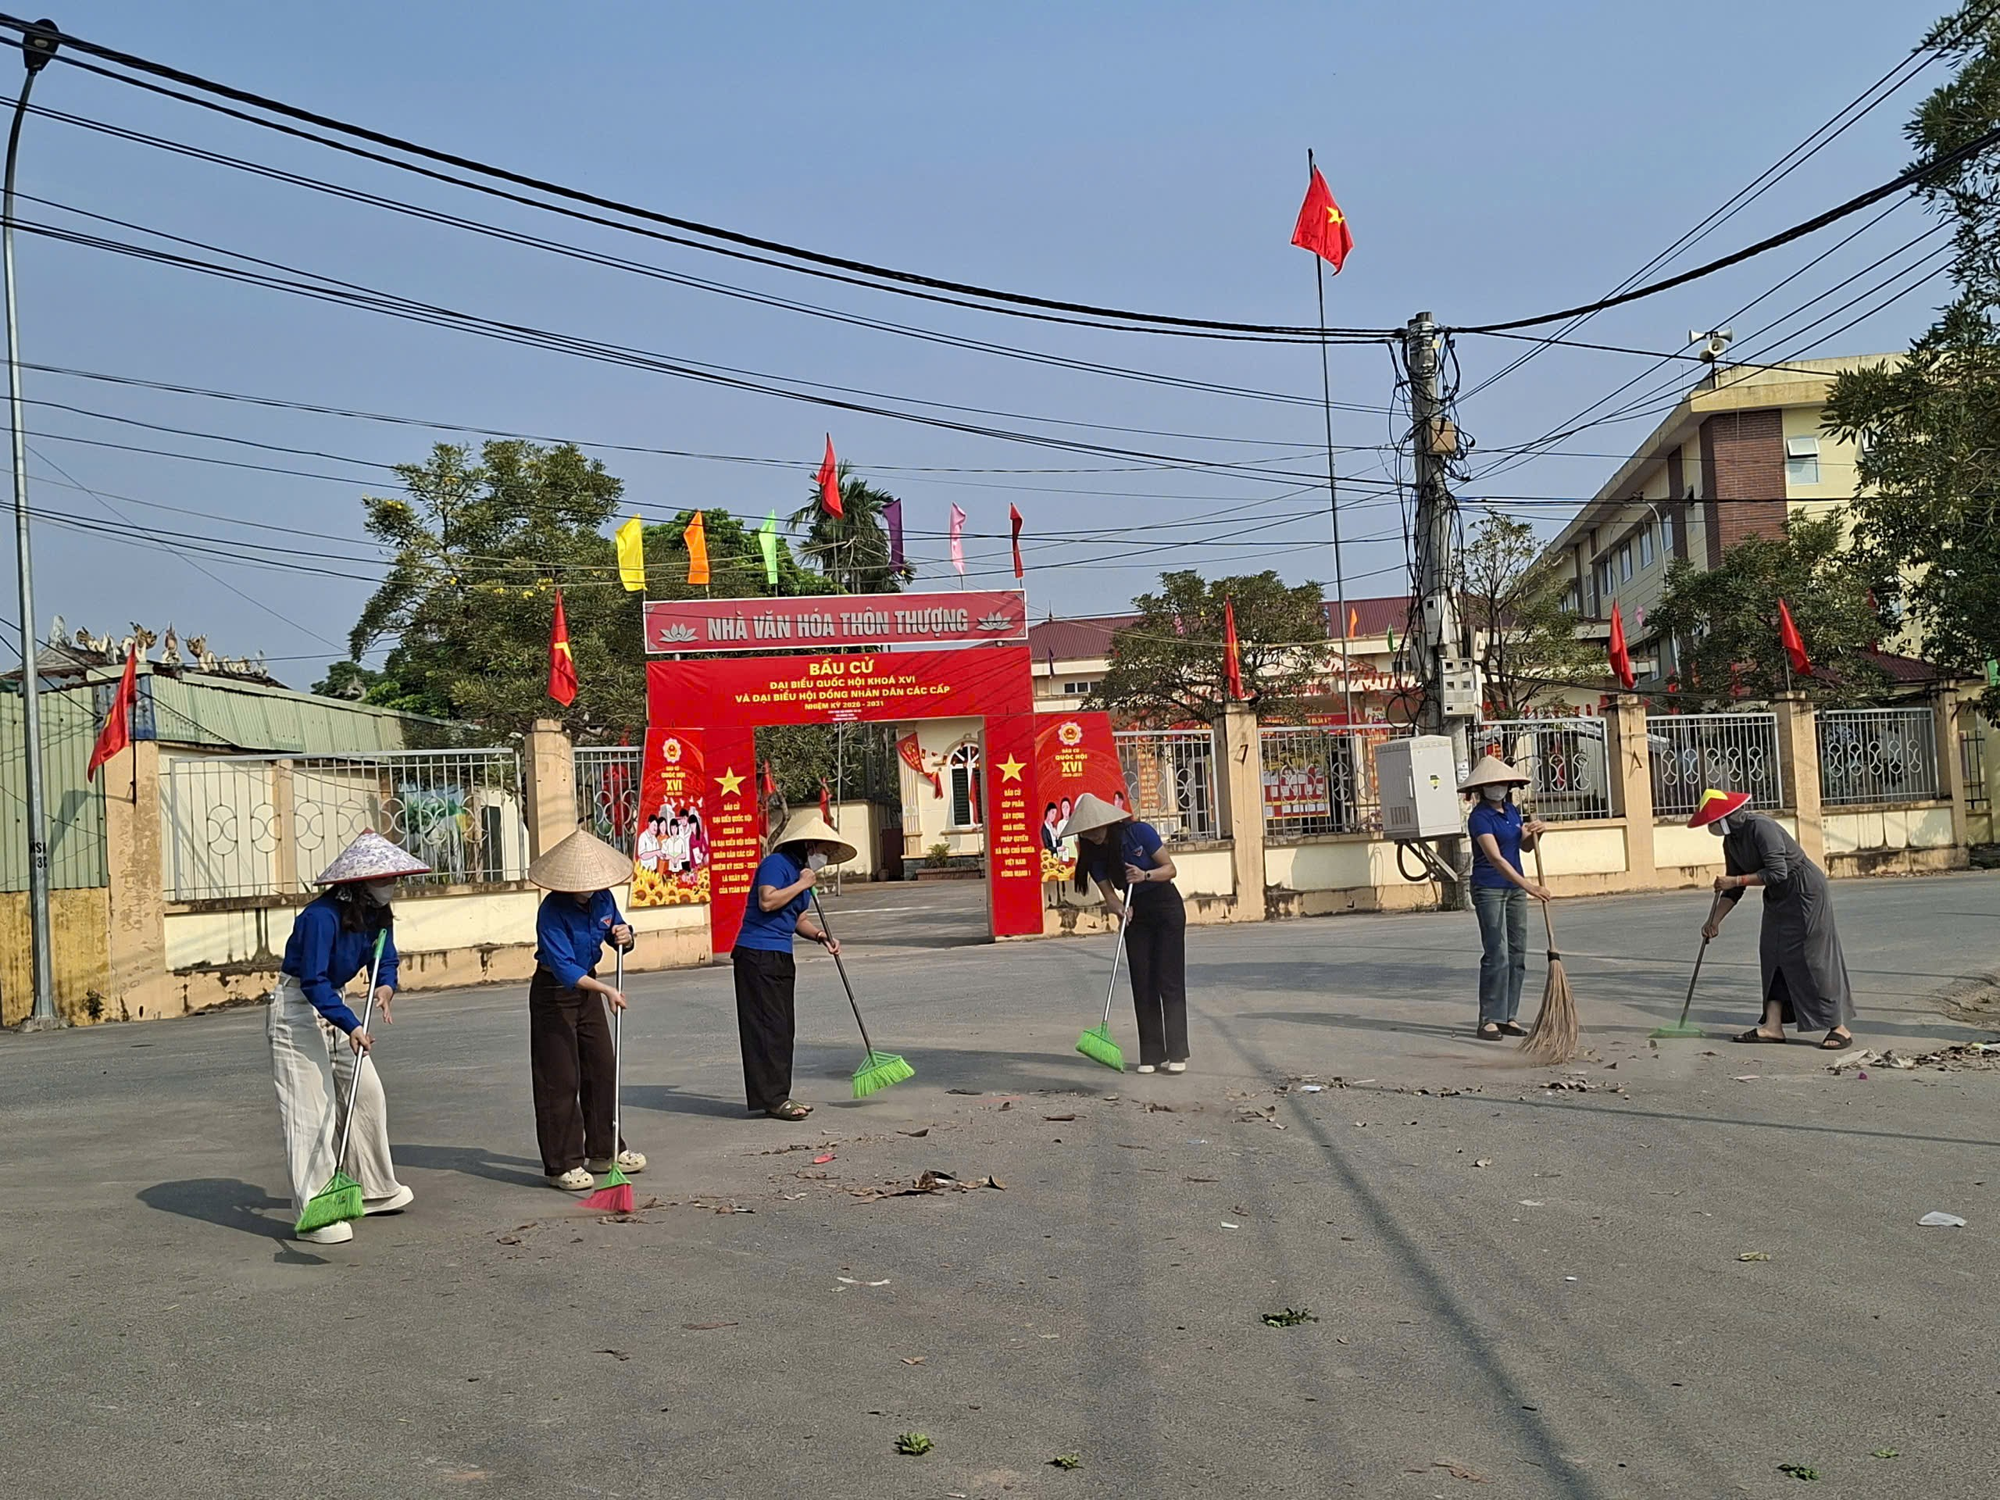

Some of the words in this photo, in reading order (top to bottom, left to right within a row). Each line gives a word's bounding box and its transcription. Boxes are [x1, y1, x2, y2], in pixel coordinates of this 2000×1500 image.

[707, 611, 748, 641] NHÀ
[753, 610, 791, 639] VĂN
[797, 608, 835, 638] HÓA
[839, 607, 889, 636] THÔN
[895, 607, 969, 638] THƯỢNG
[809, 658, 844, 676] BẦU
[849, 656, 875, 674] CỬ
[770, 681, 788, 690] ĐẠI
[791, 677, 814, 689] BIỂU
[816, 676, 845, 687] QUỐC
[847, 676, 865, 687] HỘI
[898, 675, 916, 684] XVI
[735, 692, 750, 703] VÀ
[752, 693, 771, 704] ĐẠI
[773, 690, 797, 701] BIỂU
[799, 690, 817, 701] HỘI
[850, 687, 880, 698] NHÂN
[882, 687, 905, 697] DÂN
[906, 685, 928, 695] CÁC
[929, 683, 950, 694] CẤP
[1061, 761, 1083, 773] XVI
[666, 779, 682, 791] XVI
